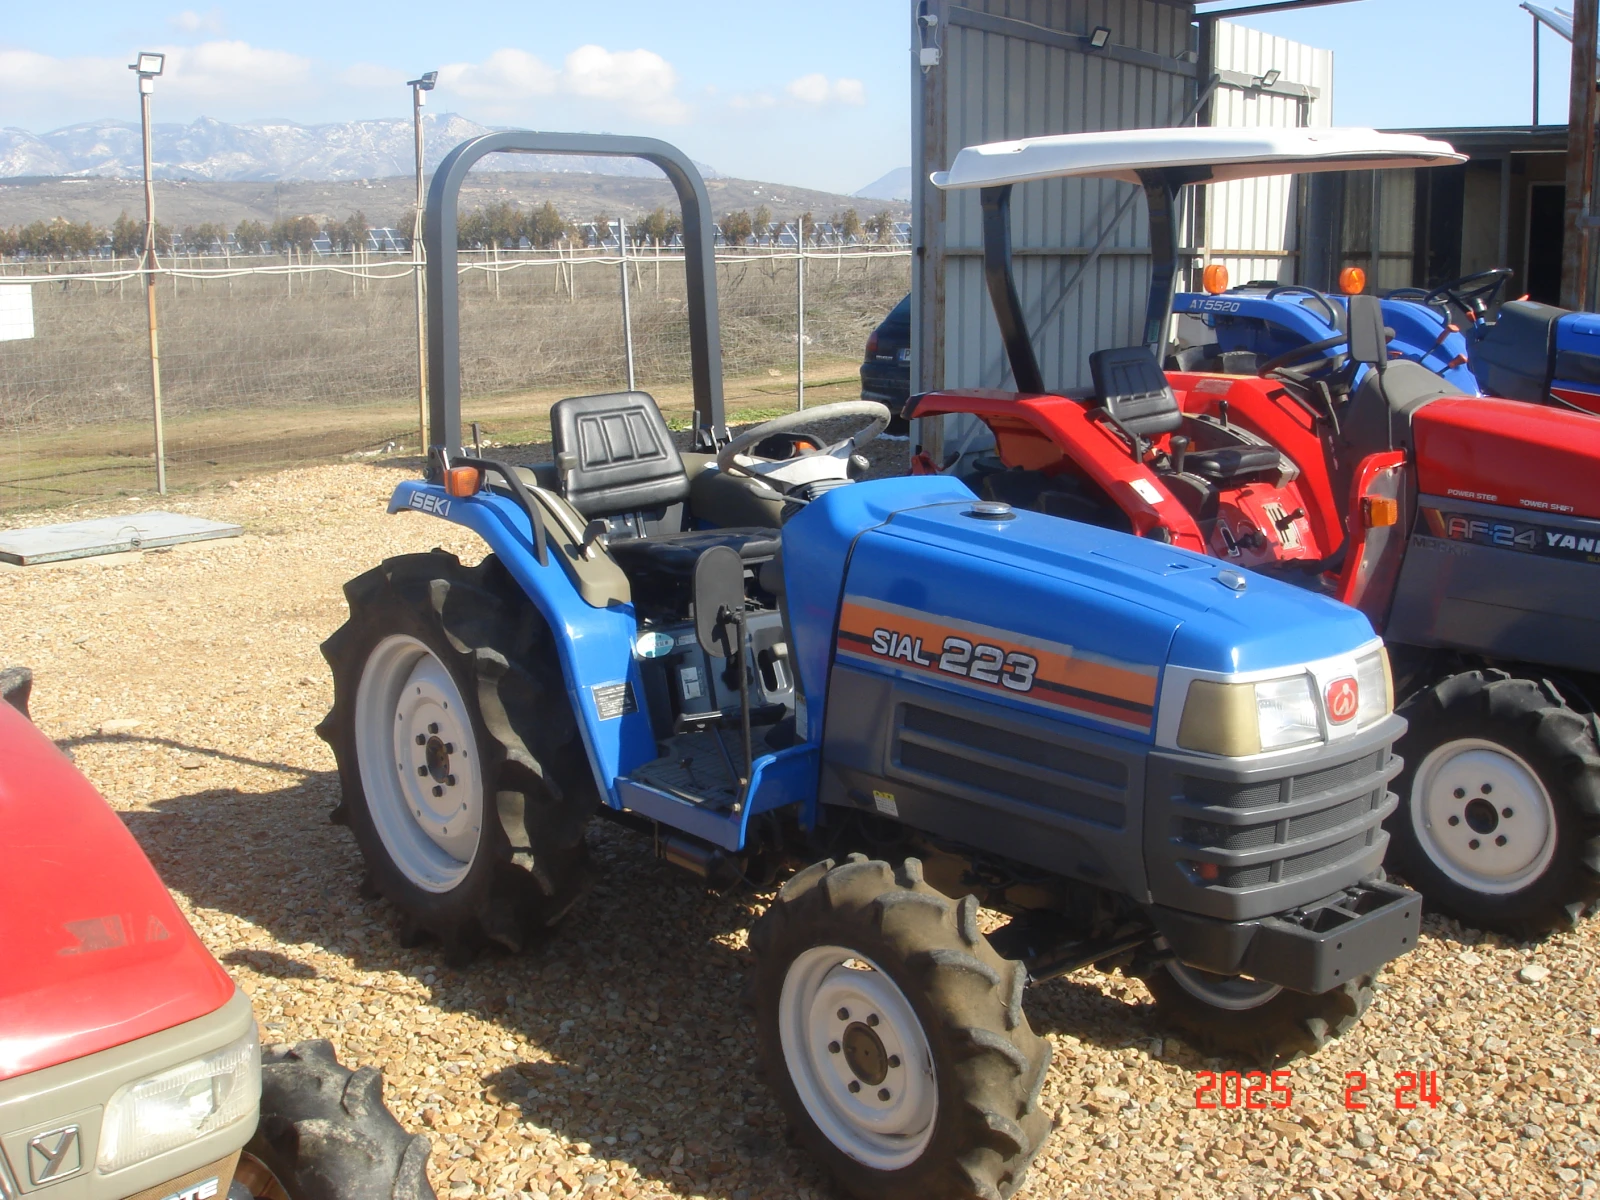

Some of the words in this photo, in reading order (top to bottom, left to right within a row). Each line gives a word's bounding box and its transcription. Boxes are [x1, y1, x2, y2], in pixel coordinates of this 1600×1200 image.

[1189, 299, 1240, 313] AT5520
[1447, 488, 1475, 498] POWER
[408, 490, 452, 517] ISEKI
[871, 628, 931, 667] SIAL
[938, 636, 1038, 692] 223
